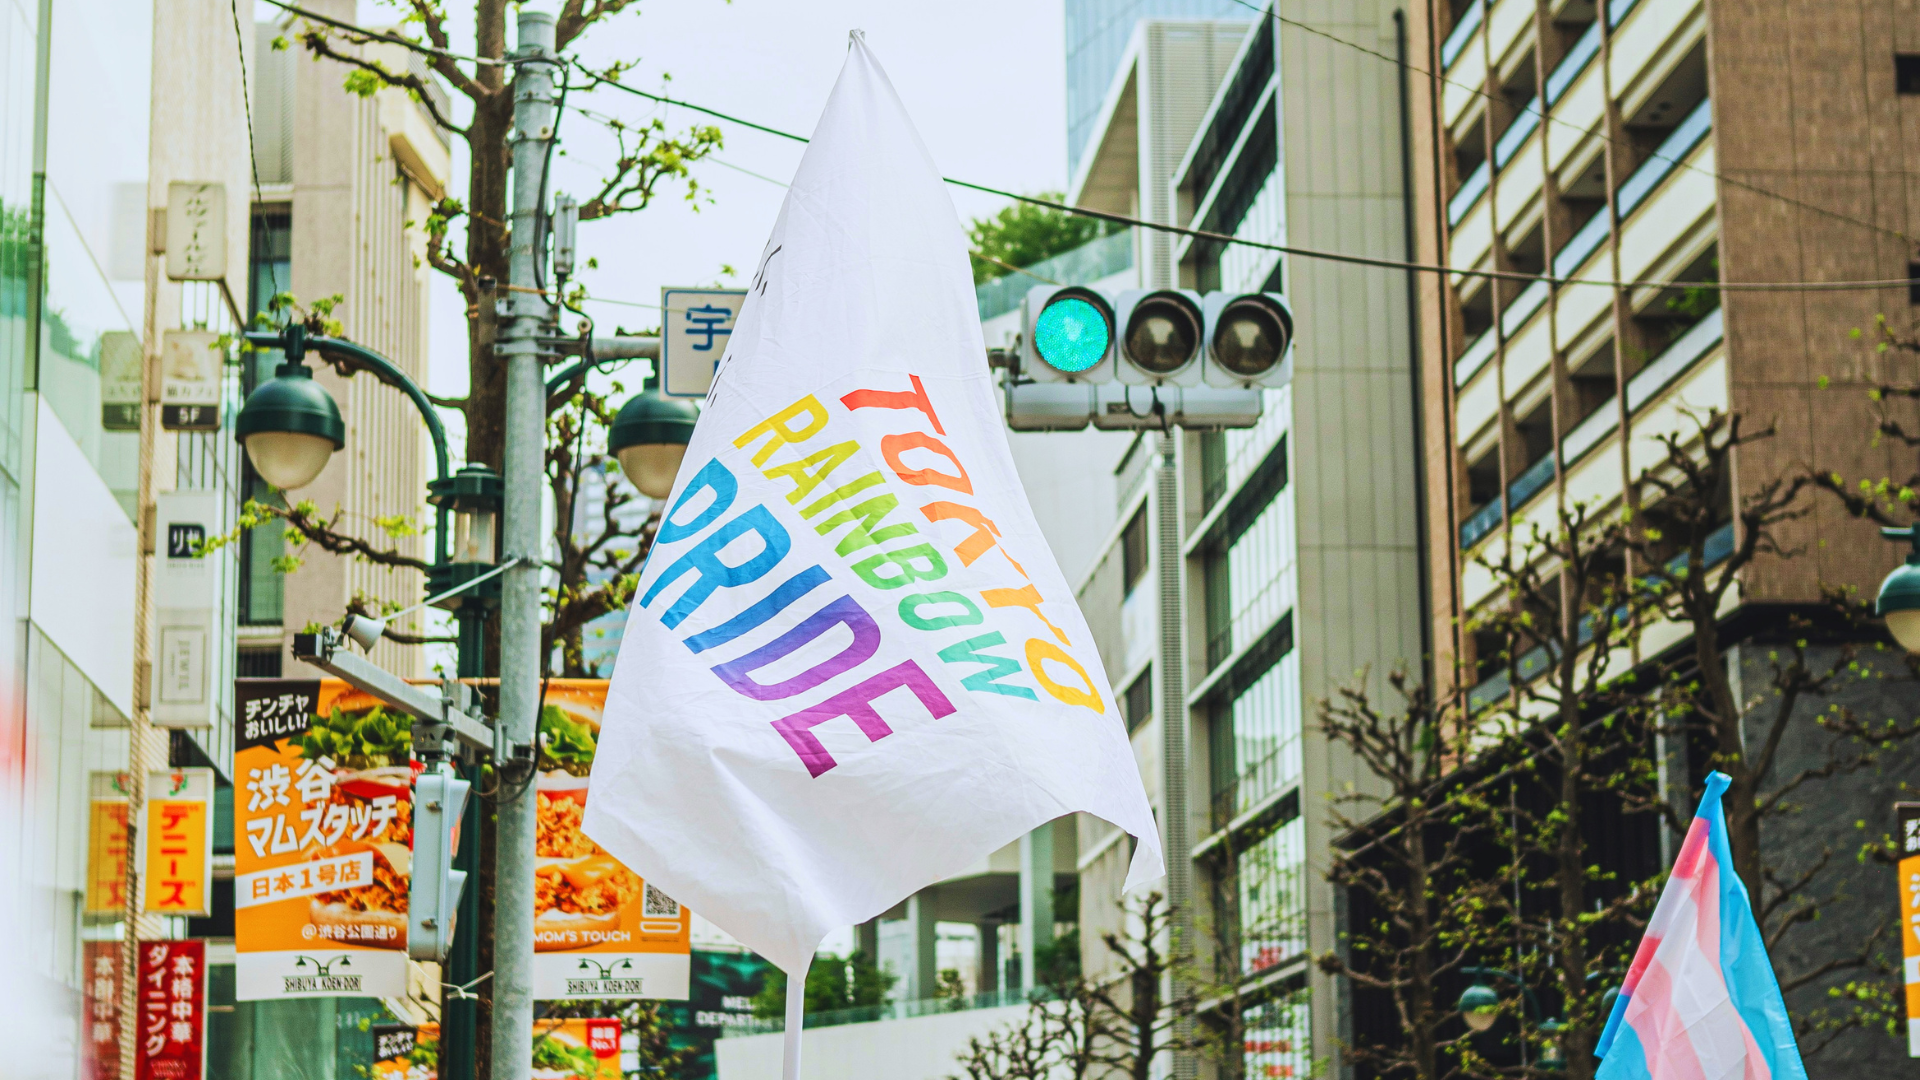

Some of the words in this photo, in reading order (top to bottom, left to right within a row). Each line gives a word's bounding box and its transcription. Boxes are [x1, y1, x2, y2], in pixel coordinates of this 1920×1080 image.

[685, 304, 732, 351] 宇
[178, 406, 200, 424] 5F
[732, 394, 1040, 702] RAINBOW
[640, 457, 957, 780] PRIDE
[245, 694, 309, 721] チンチャ
[245, 712, 308, 740] おいしい!
[246, 755, 339, 812] 渋谷
[246, 795, 398, 858] マムズタッチ
[159, 805, 199, 907] デニーズ
[252, 860, 361, 899] 日本1号店
[534, 929, 578, 942] MOM'S
[581, 931, 631, 942] TOUCH
[145, 944, 169, 1057] ダイニング
[284, 977, 317, 991] SHIBUYA
[321, 976, 361, 991] KOEN-DORI
[567, 979, 599, 993] SHIBUYA
[603, 979, 643, 993] KOEN-DORI
[591, 1040, 616, 1051] No.1
